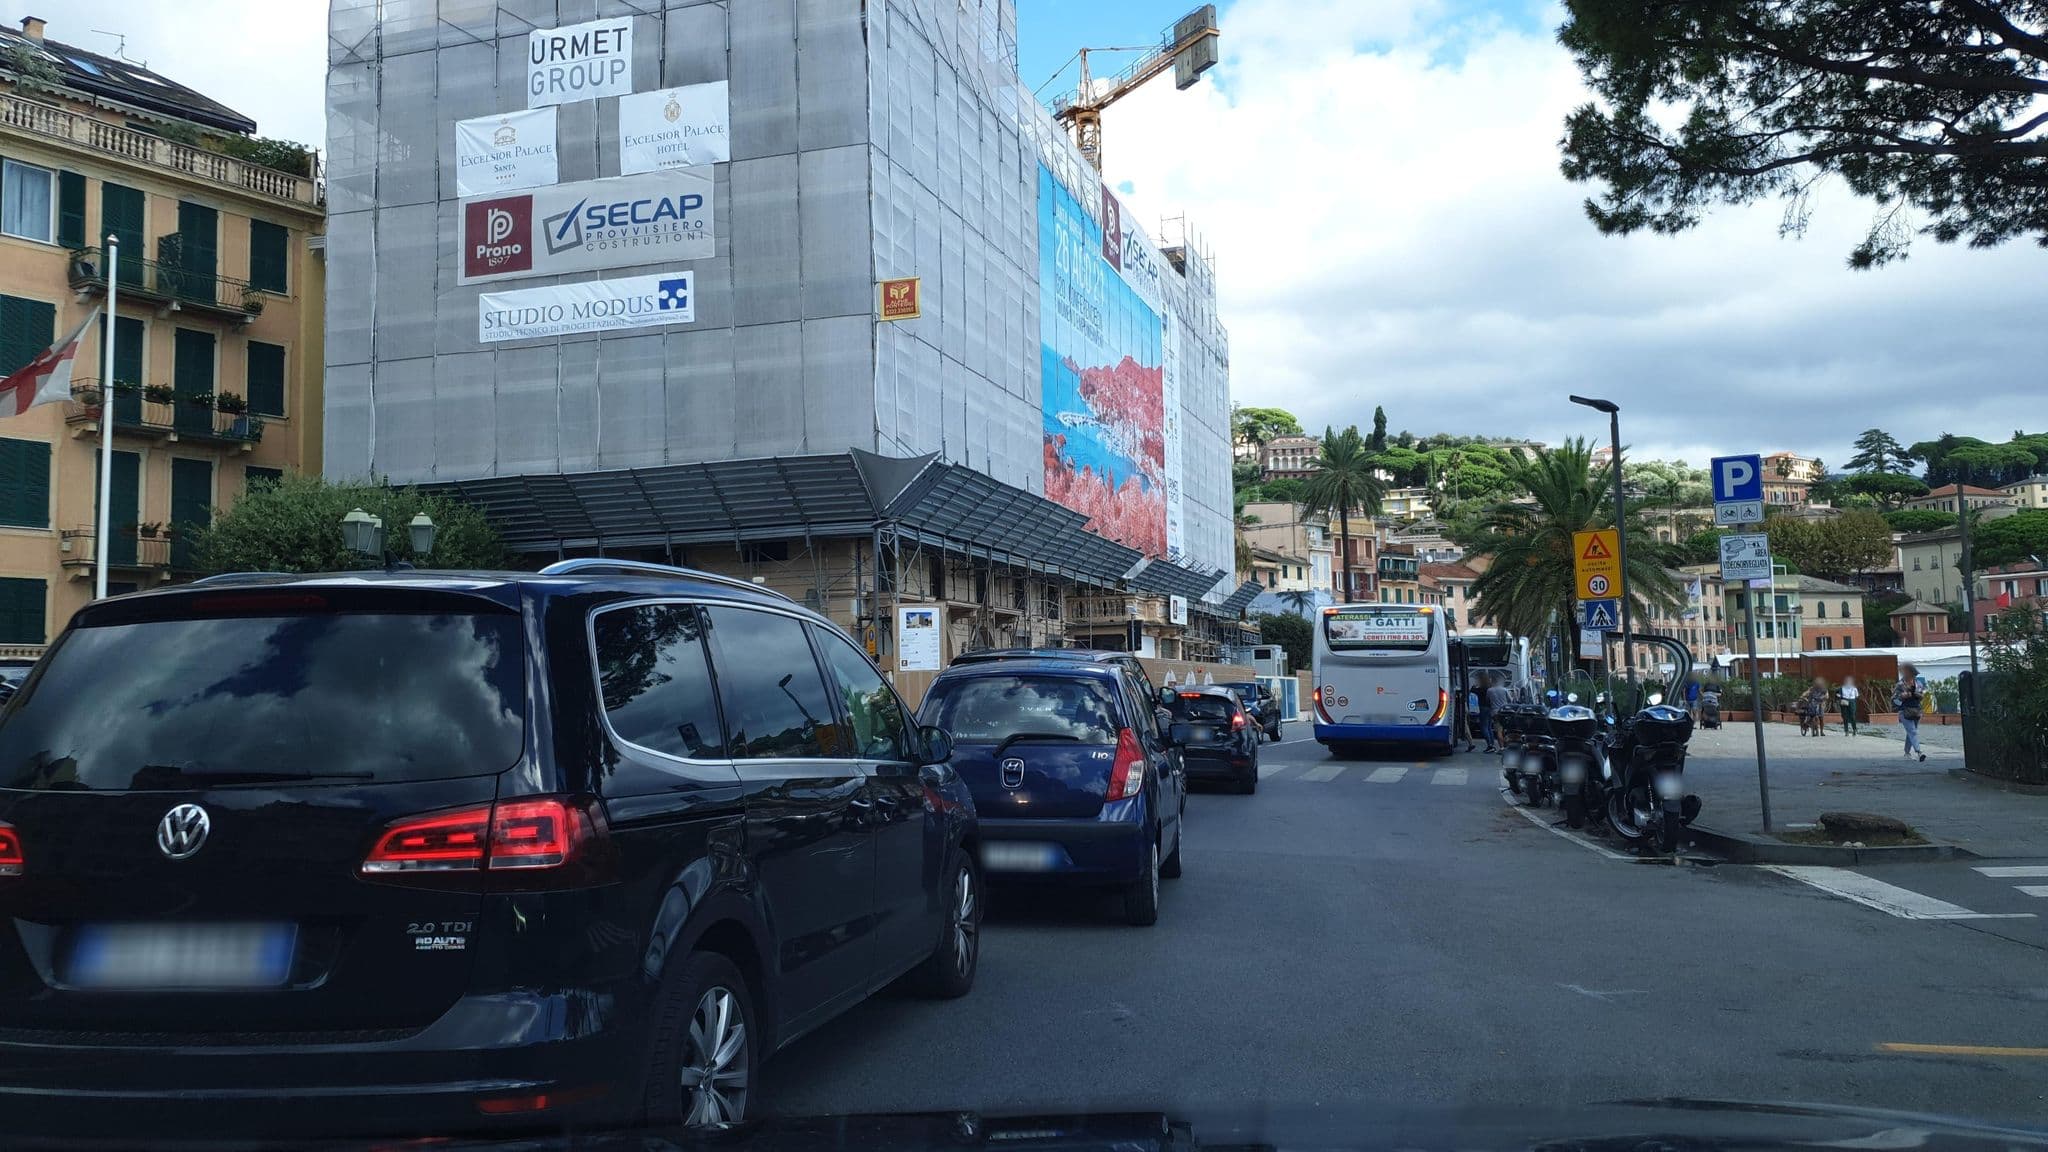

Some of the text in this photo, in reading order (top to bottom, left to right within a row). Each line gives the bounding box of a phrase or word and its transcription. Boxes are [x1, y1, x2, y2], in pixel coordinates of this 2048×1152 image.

[531, 26, 628, 65] URMET
[531, 58, 626, 96] GROUP
[460, 143, 553, 168] EXCELSIOR PALACE
[656, 142, 690, 155] HOTEL
[585, 193, 704, 231] SECAP
[585, 219, 704, 242] PROVVISIERO
[585, 231, 704, 253] COSTRUZIONI
[475, 242, 523, 260] Prono
[484, 294, 655, 330] STUDIO MODUS
[1722, 461, 1753, 497] P
[1592, 580, 1606, 591] 30
[1375, 618, 1415, 627] GATTI
[441, 921, 473, 933] TDI
